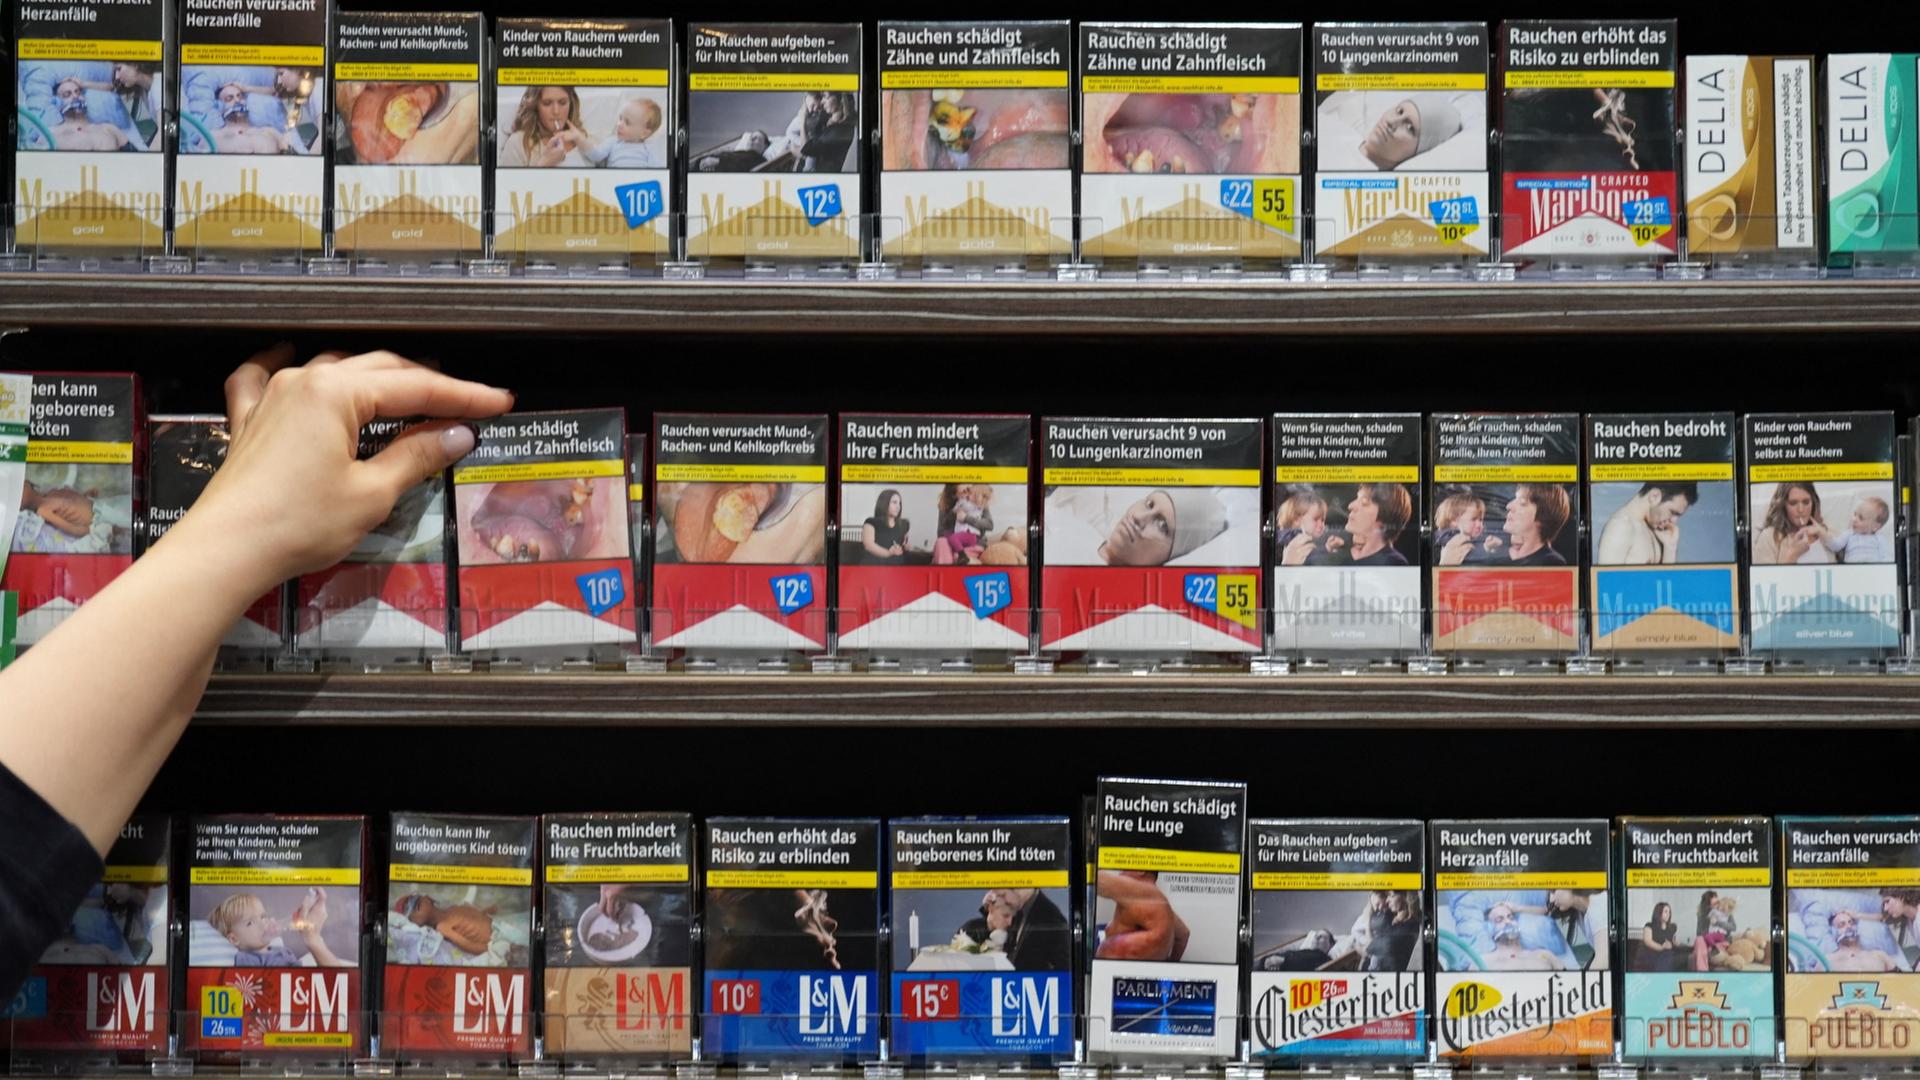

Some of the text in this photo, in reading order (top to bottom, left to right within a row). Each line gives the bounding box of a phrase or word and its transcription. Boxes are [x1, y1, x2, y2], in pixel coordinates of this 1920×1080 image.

[21, 6, 96, 21] Herzanfälle
[186, 12, 261, 27] Herzanfälle
[340, 24, 467, 38] Rauchen verursacht Mund-,
[503, 30, 659, 46] Kinder von Rauchern werden
[886, 28, 1021, 48] Rauchen schädigt
[1321, 31, 1479, 46] Rauchen verursacht 9 von
[1510, 26, 1666, 44] Rauchen erhöht das
[340, 36, 468, 51] Rachen- und Kehlkopfkrebs
[502, 44, 622, 57] oft selbst zu Rauchern
[696, 34, 824, 50] Das Rauchen aufgeben
[696, 50, 848, 63] für Ihre Lieben weiterleben
[886, 48, 1060, 65] Zähne und Zahnfleisch
[1322, 48, 1458, 66] 10 Lungenkarzinomen
[1510, 48, 1659, 65] Risiko zu erblinden
[1697, 68, 1726, 173] DELIA
[1794, 107, 1803, 139] macht
[1839, 66, 1868, 171] DELIA
[1781, 73, 1793, 234] Dieses Tabakerzeugnis schädigt
[1795, 142, 1804, 160] und
[1414, 176, 1461, 187] CRAFTED
[1601, 175, 1649, 187] CRAFTED
[20, 165, 160, 222] Marlboro
[1262, 189, 1285, 213] 55
[1440, 202, 1461, 224] 28
[1633, 202, 1653, 224] 28
[73, 225, 104, 235] gold
[60, 381, 97, 396] kann
[30, 420, 69, 436] töten
[847, 421, 978, 439] Rauchen mindert
[1049, 424, 1226, 440] Rauchen verursacht 9 von
[1281, 422, 1403, 436] Wenn Sie rauchen, schaden
[1594, 420, 1726, 437] Rauchen bedroht
[1754, 420, 1851, 432] Kinder von Rauchern
[1281, 434, 1385, 448] Sie Ihren Kindern, Ihrer
[1754, 434, 1807, 445] werden oft
[846, 442, 984, 460] Ihre Fruchtbarkeit
[1049, 443, 1202, 462] 10 Lungenkarzinomen
[1281, 448, 1387, 459] Familie, Ihren Freunden
[1594, 441, 1681, 458] Ihre Potenz
[1754, 446, 1842, 459] selbst zu Rauchern
[1226, 584, 1248, 608] 55
[1755, 569, 1895, 627] Marlboro
[1602, 579, 1729, 631] Marlboro
[1635, 633, 1698, 644] simply blue
[1796, 629, 1853, 638] silver blue
[1104, 795, 1236, 818] Rauchen schädigt
[550, 821, 676, 839] Rauchen mindert
[1104, 815, 1183, 837] Ihre Lunge
[711, 827, 856, 844] Rauchen erhöht das
[1258, 833, 1387, 850] Das Rauchen aufgeben
[1440, 828, 1591, 846] Rauchen verursacht
[550, 841, 681, 858] Ihre Fruchtbarkeit
[711, 846, 849, 864] Risiko zu erblinden
[1258, 848, 1411, 863] für Ihre Lieben weiterleben
[1440, 849, 1528, 868] Herzanfälle
[1116, 980, 1212, 1000] PARLIAMENT
[280, 972, 348, 1032] L&M
[453, 972, 524, 1034] L&M
[799, 975, 867, 1034] L&M
[1255, 972, 1421, 1051] Chesterfield
[211, 1019, 224, 1036] 26
[1648, 1008, 1749, 1049] PUEBLO
